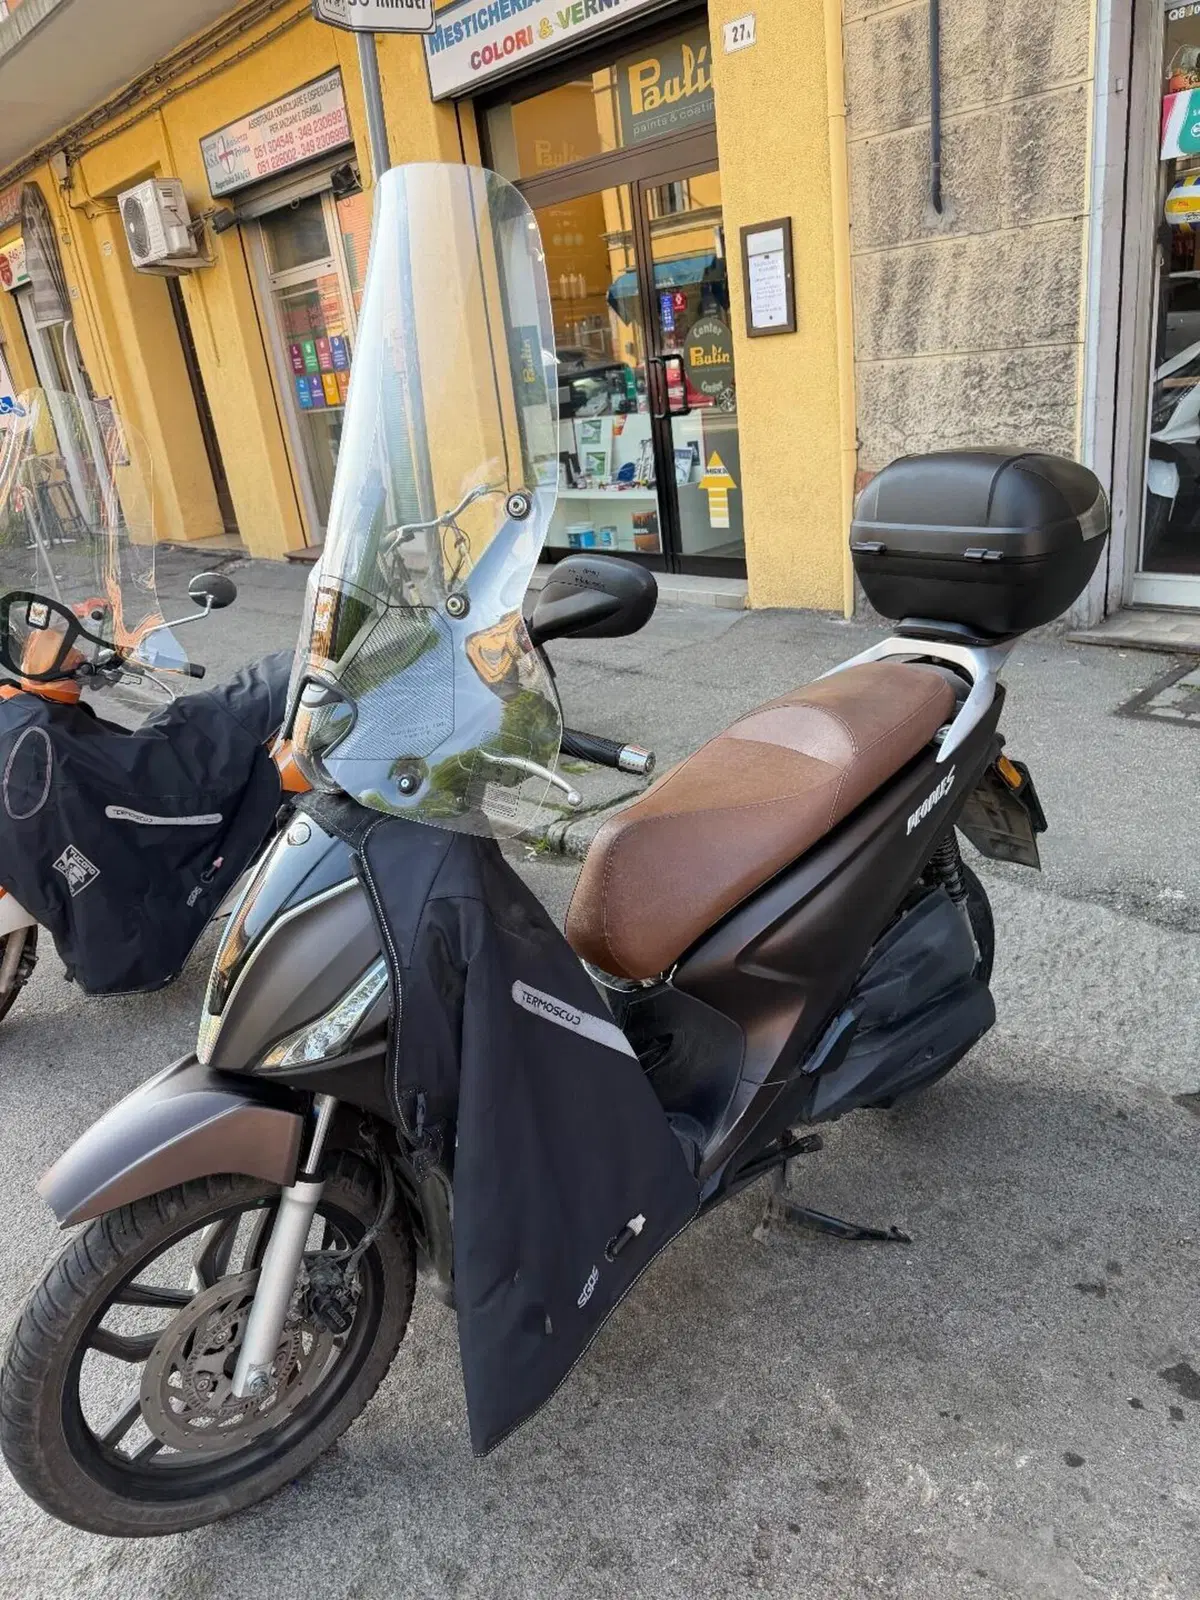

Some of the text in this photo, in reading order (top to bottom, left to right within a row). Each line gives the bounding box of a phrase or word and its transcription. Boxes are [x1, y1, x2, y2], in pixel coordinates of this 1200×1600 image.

[428, 0, 541, 56] MESTICHER
[470, 25, 534, 71] COLORI
[539, 17, 554, 40] &
[633, 117, 668, 138] paints
[254, 144, 267, 159] 051
[257, 160, 270, 174] 051
[693, 322, 723, 338] Center
[70, 848, 97, 876] TUCANO
